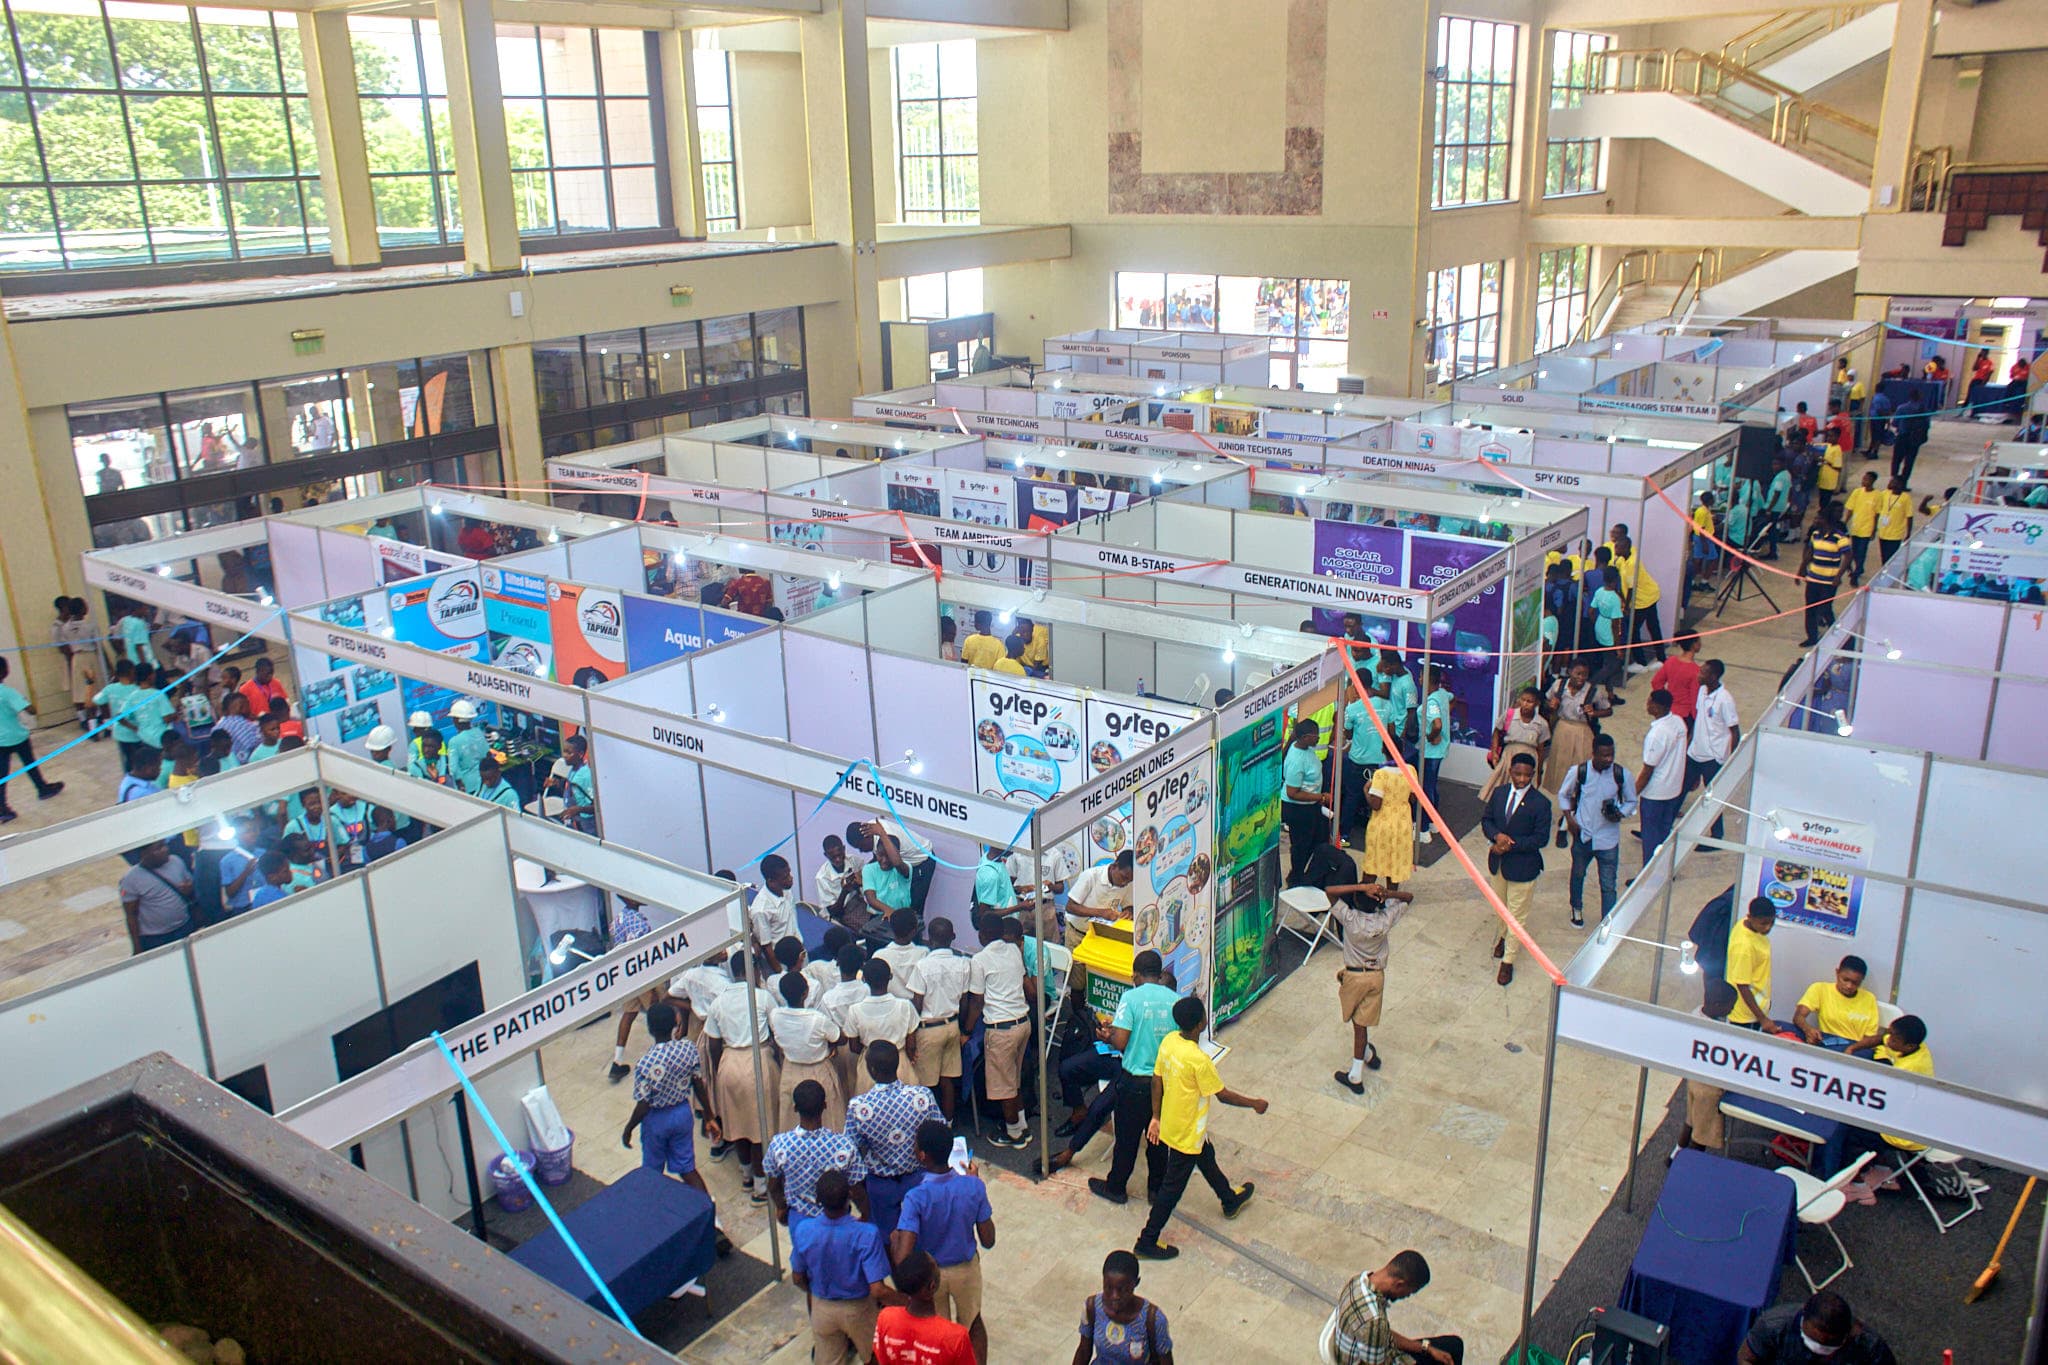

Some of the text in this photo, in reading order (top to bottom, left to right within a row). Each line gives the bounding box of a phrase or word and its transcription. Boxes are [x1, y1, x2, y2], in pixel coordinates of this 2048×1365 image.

[1161, 351, 1191, 360] SPONSORS
[1501, 394, 1524, 404] SOLID
[875, 407, 927, 422] GAME CHANGERS
[1659, 404, 1683, 414] STEM
[1685, 405, 1709, 415] TEAM
[976, 415, 1039, 430] STEM TECHNICIANS
[1105, 429, 1149, 443] CLASSICALS
[1247, 444, 1293, 457] TECHSTARS
[558, 467, 575, 478] TEAM
[1362, 455, 1436, 474] IDEATION NINJAS
[1534, 473, 1580, 486] SPY KIDS
[704, 490, 720, 501] CAN
[811, 507, 849, 523] SUPREME
[934, 526, 1013, 548] TEAM AMBITIOUS
[1098, 550, 1175, 574] OTMA B-STARS
[1334, 547, 1382, 563] SOLAR
[1321, 556, 1395, 576] MOSQUITO
[1244, 571, 1413, 610] GENERATIONAL INNOVATORS
[439, 602, 478, 620] TAPWAD
[586, 621, 619, 638] TAPWAD
[663, 627, 702, 651] Aqua
[327, 633, 387, 660] GIFTED HANDS
[467, 671, 532, 700] AQUASENTRY
[1244, 667, 1318, 719] SCIENCE BREAKERS
[989, 692, 1048, 726] gstep
[1105, 711, 1171, 740] gstep
[652, 726, 704, 753] DIVISION
[1080, 747, 1175, 814] THE CHOSEN ONES
[836, 772, 969, 821] THE CHOSEN ONES
[1146, 771, 1190, 819] gstep
[1802, 821, 1833, 836] gstep
[1800, 834, 1863, 855] ARCHIMEDES
[493, 980, 592, 1046] PATRIOTS
[595, 964, 619, 992] OF
[624, 932, 690, 978] GHANA
[1691, 1039, 1888, 1111] ROYAL STARS
